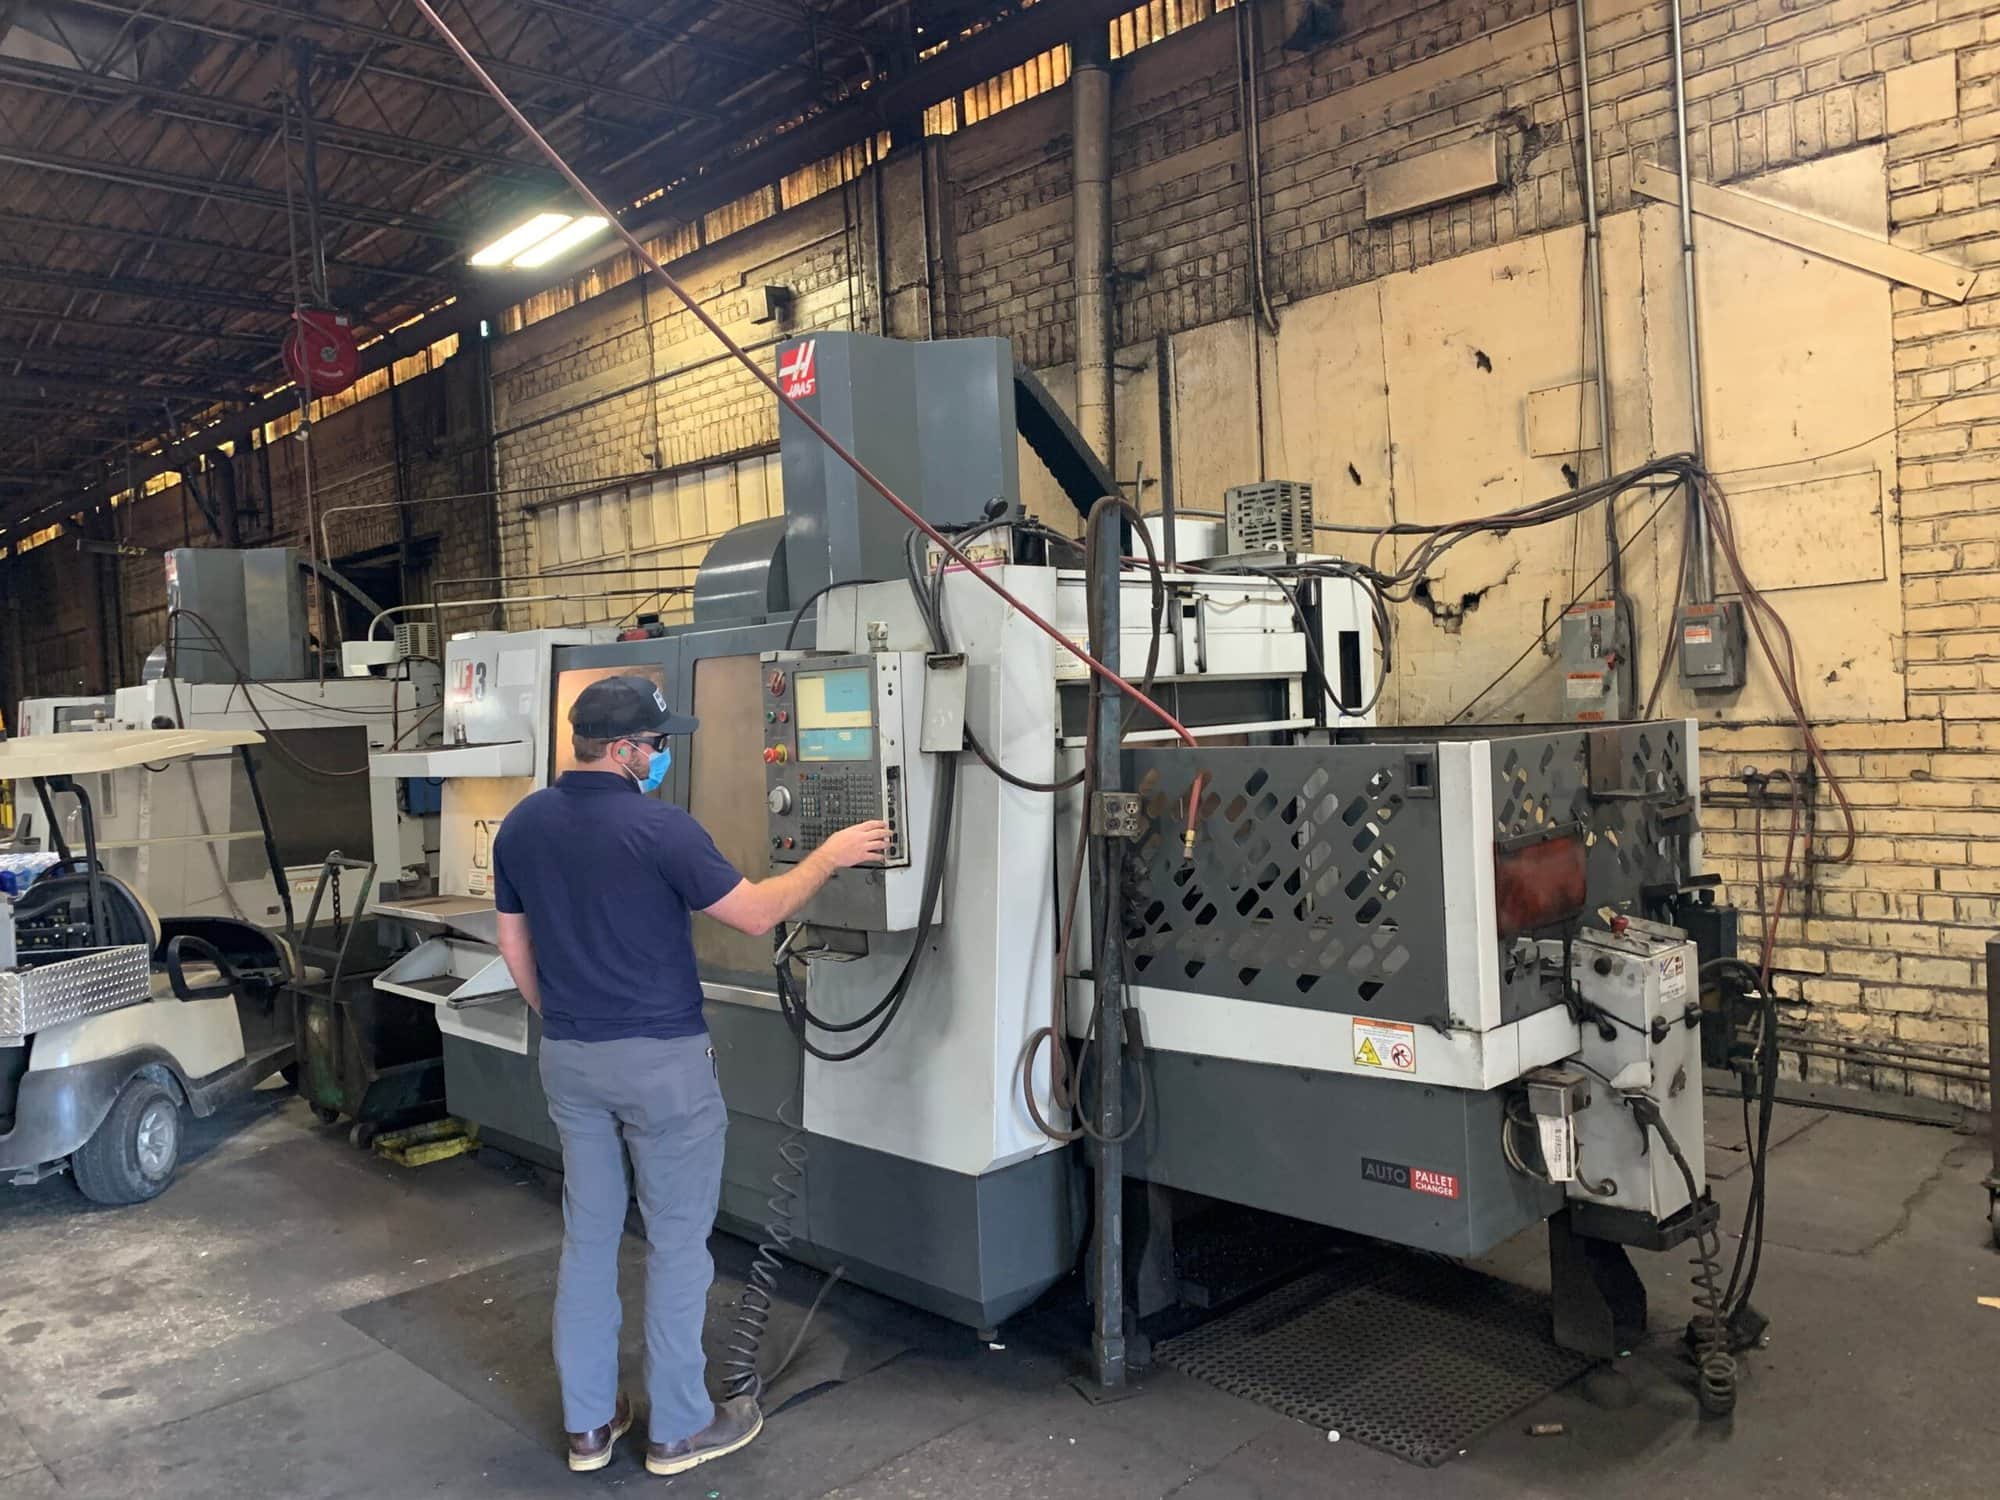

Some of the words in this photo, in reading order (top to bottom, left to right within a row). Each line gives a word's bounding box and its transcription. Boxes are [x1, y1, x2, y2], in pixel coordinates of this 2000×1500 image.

[1365, 1163, 1407, 1184] AUTO
[1415, 1170, 1453, 1188] PALLET
[1415, 1181, 1454, 1197] CHANGER
